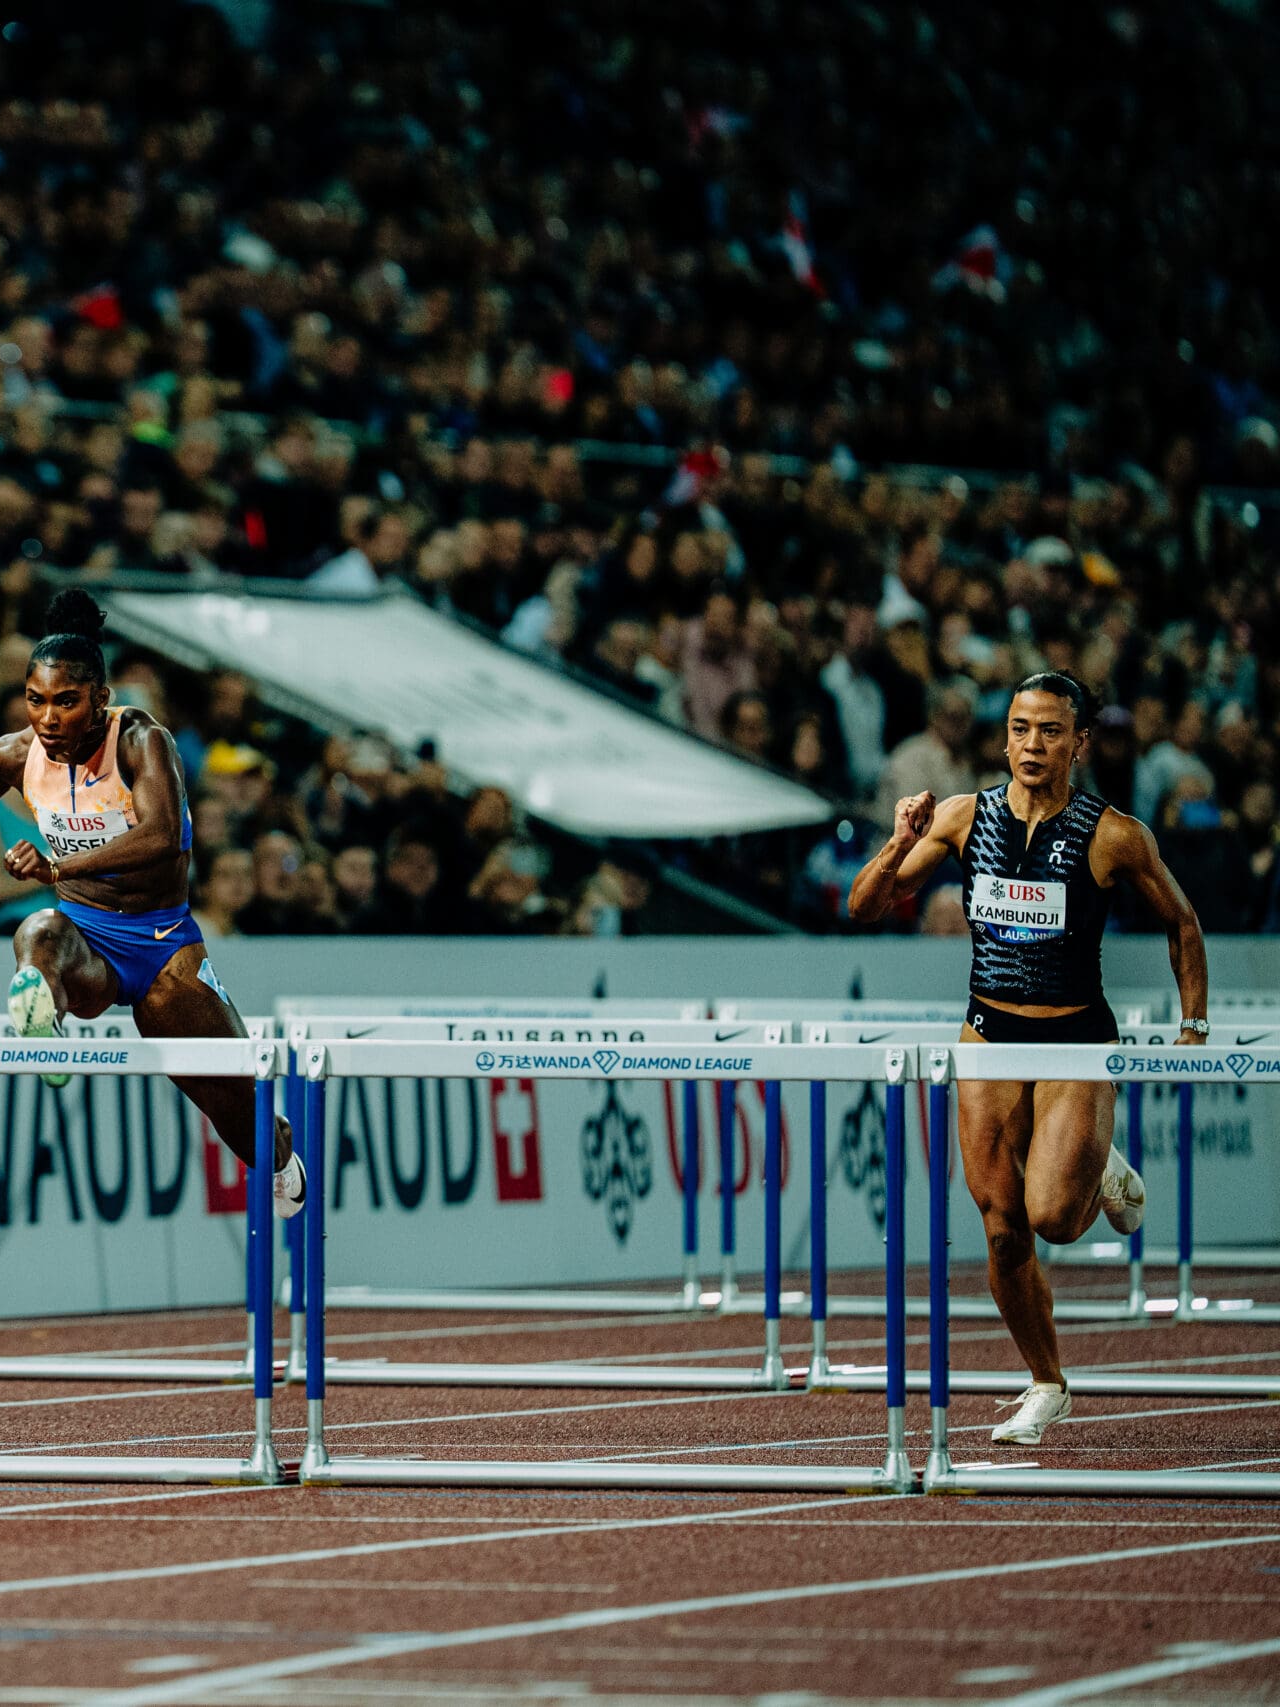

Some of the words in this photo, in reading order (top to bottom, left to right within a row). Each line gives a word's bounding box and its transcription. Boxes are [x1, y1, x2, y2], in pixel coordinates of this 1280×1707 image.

[66, 816, 106, 832] UBS
[46, 833, 107, 854] RUSSE
[1008, 884, 1046, 902] UBS
[975, 905, 1059, 925] KAMBUNDJI
[446, 1024, 646, 1042] Lausanne
[1, 1050, 69, 1063] DIAMOND
[72, 1051, 129, 1064] LEAGUE
[622, 1057, 692, 1070] DIAMOND
[695, 1058, 753, 1071] LEAGUE
[332, 1076, 481, 1211] AUD
